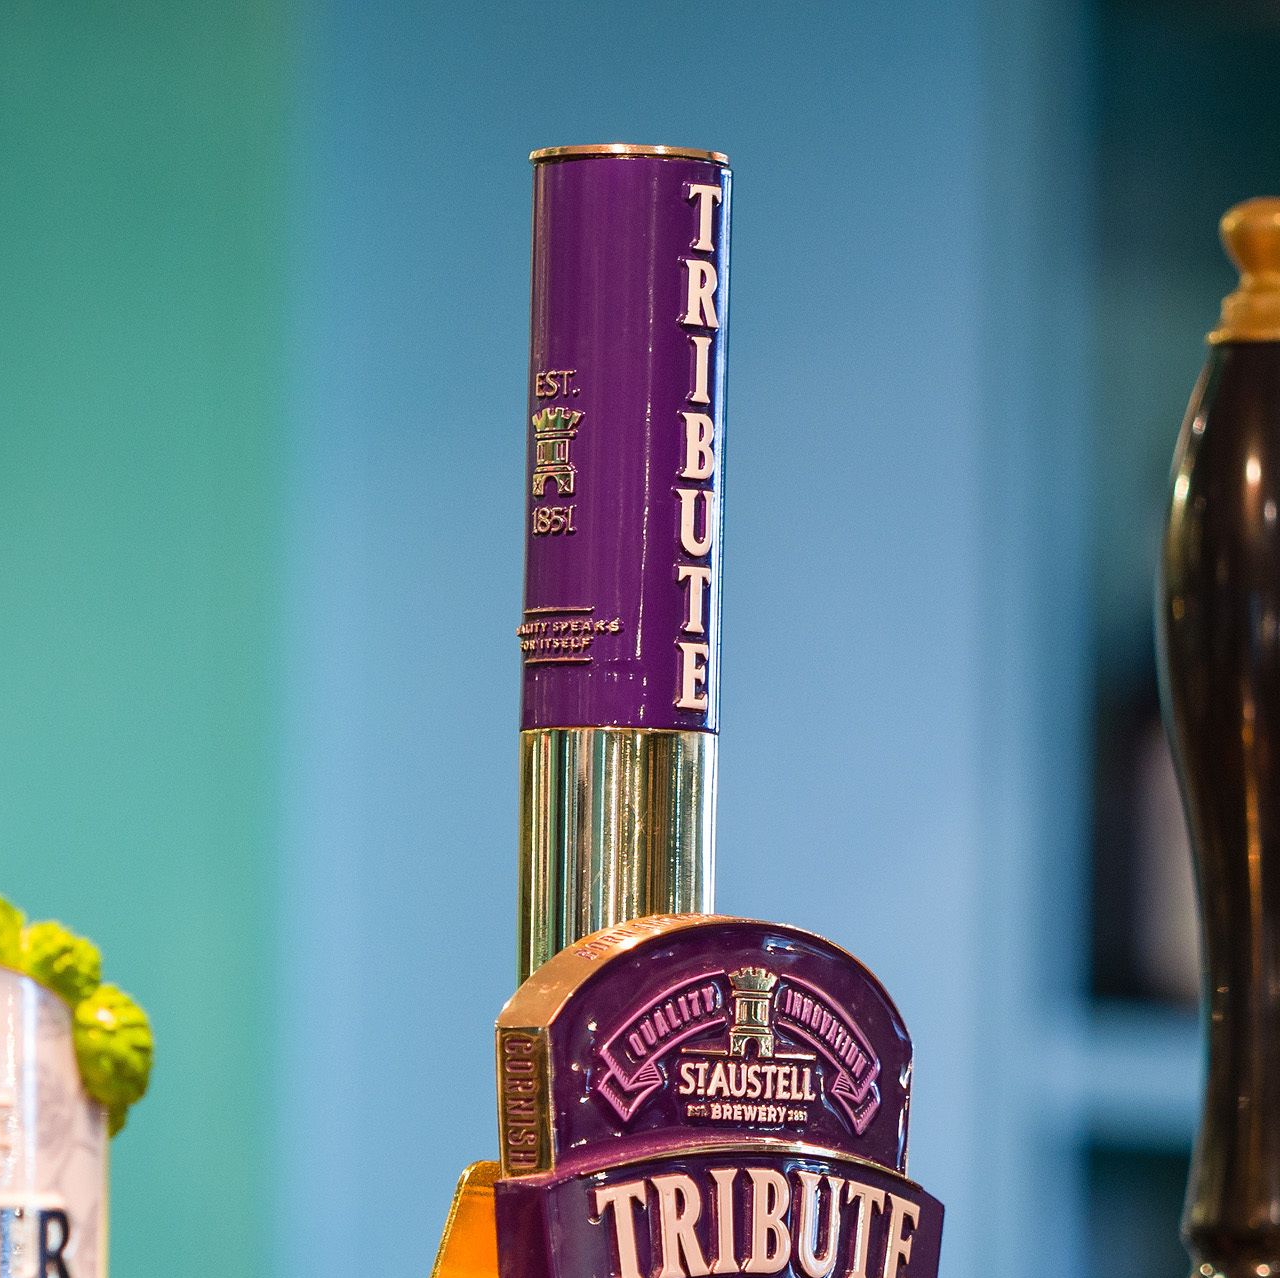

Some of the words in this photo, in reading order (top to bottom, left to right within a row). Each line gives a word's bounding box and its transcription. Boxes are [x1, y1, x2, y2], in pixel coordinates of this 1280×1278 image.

[535, 371, 579, 397] EST.
[676, 183, 722, 710] TRIBUTE
[532, 505, 577, 534] 1851
[552, 617, 620, 632] SPEAKS
[539, 636, 592, 649] ITSELF
[628, 985, 715, 1057] QUALITY
[785, 988, 869, 1079] INNOVATION
[706, 1061, 817, 1101] AUSTELL
[504, 1037, 538, 1168] CORNISH
[711, 1103, 786, 1123] BREWERY
